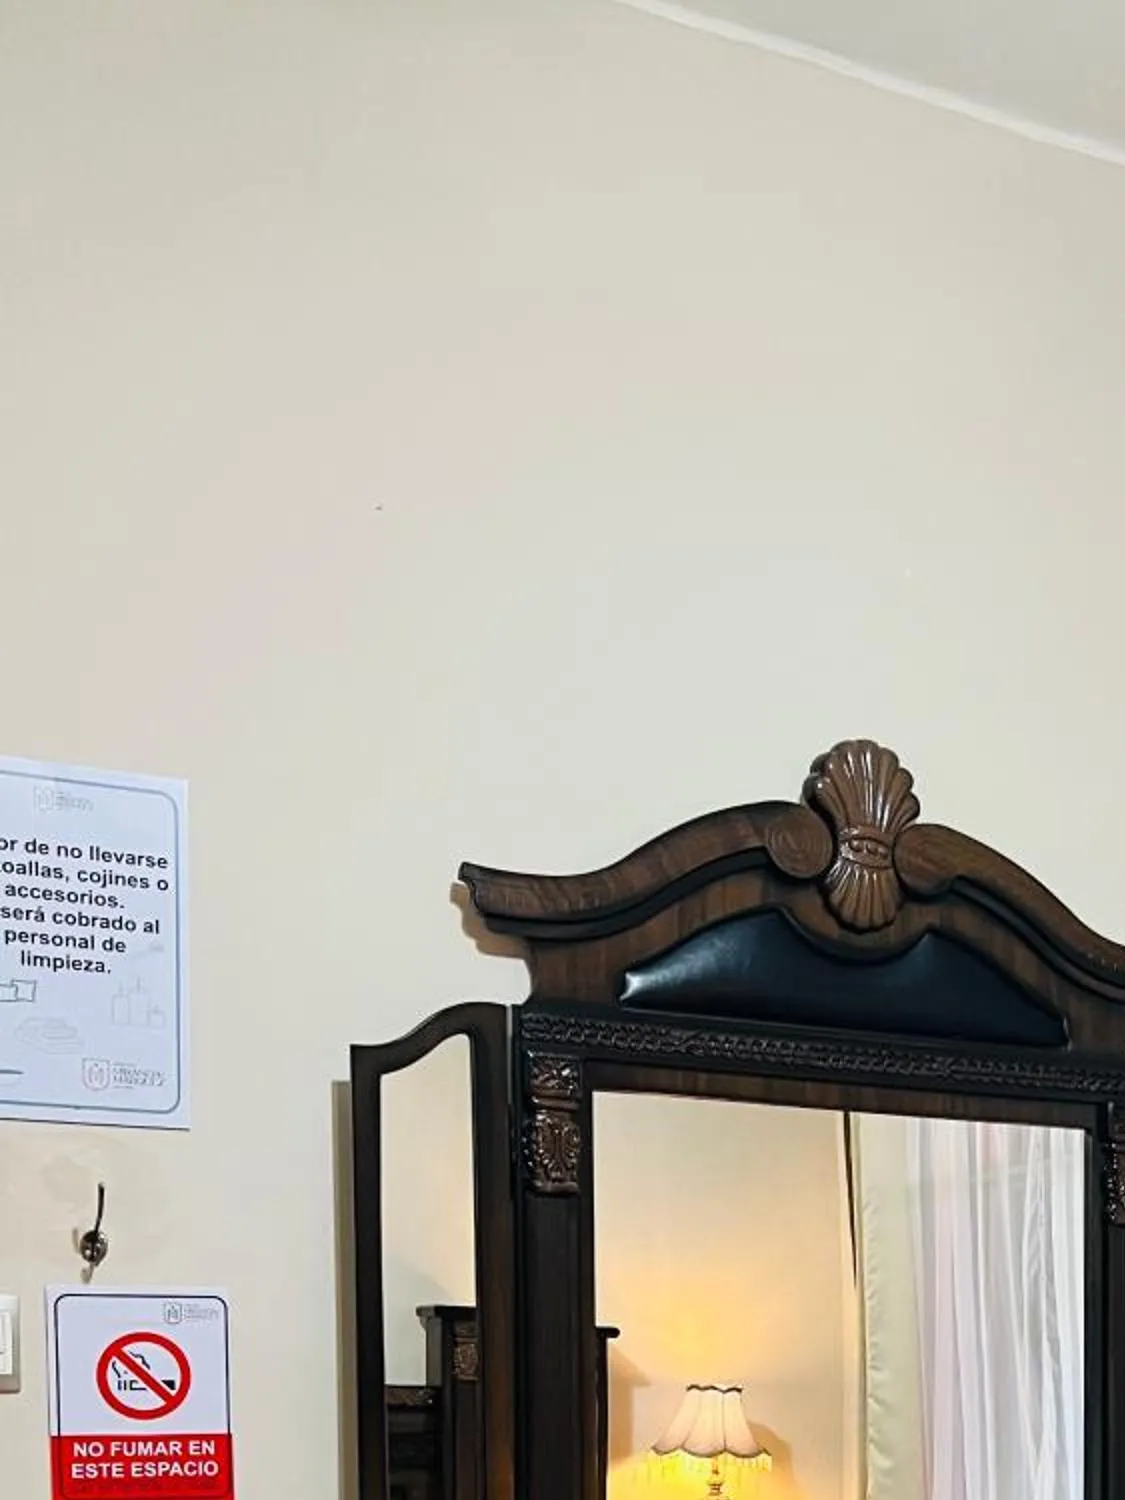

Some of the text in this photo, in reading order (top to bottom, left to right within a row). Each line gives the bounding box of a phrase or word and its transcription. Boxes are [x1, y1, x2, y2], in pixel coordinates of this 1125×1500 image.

[25, 838, 49, 855] de
[57, 845, 83, 860] no
[89, 846, 168, 869] llevarse
[77, 869, 150, 889] cojines
[157, 879, 169, 891] o
[5, 884, 125, 909] accesorios.
[0, 905, 160, 934] será cobrado al
[4, 929, 127, 953] personal de
[20, 950, 112, 974] limpieza.
[73, 1439, 215, 1457] NO FUMAR EN
[71, 1460, 219, 1479] ESTE ESPACIO
